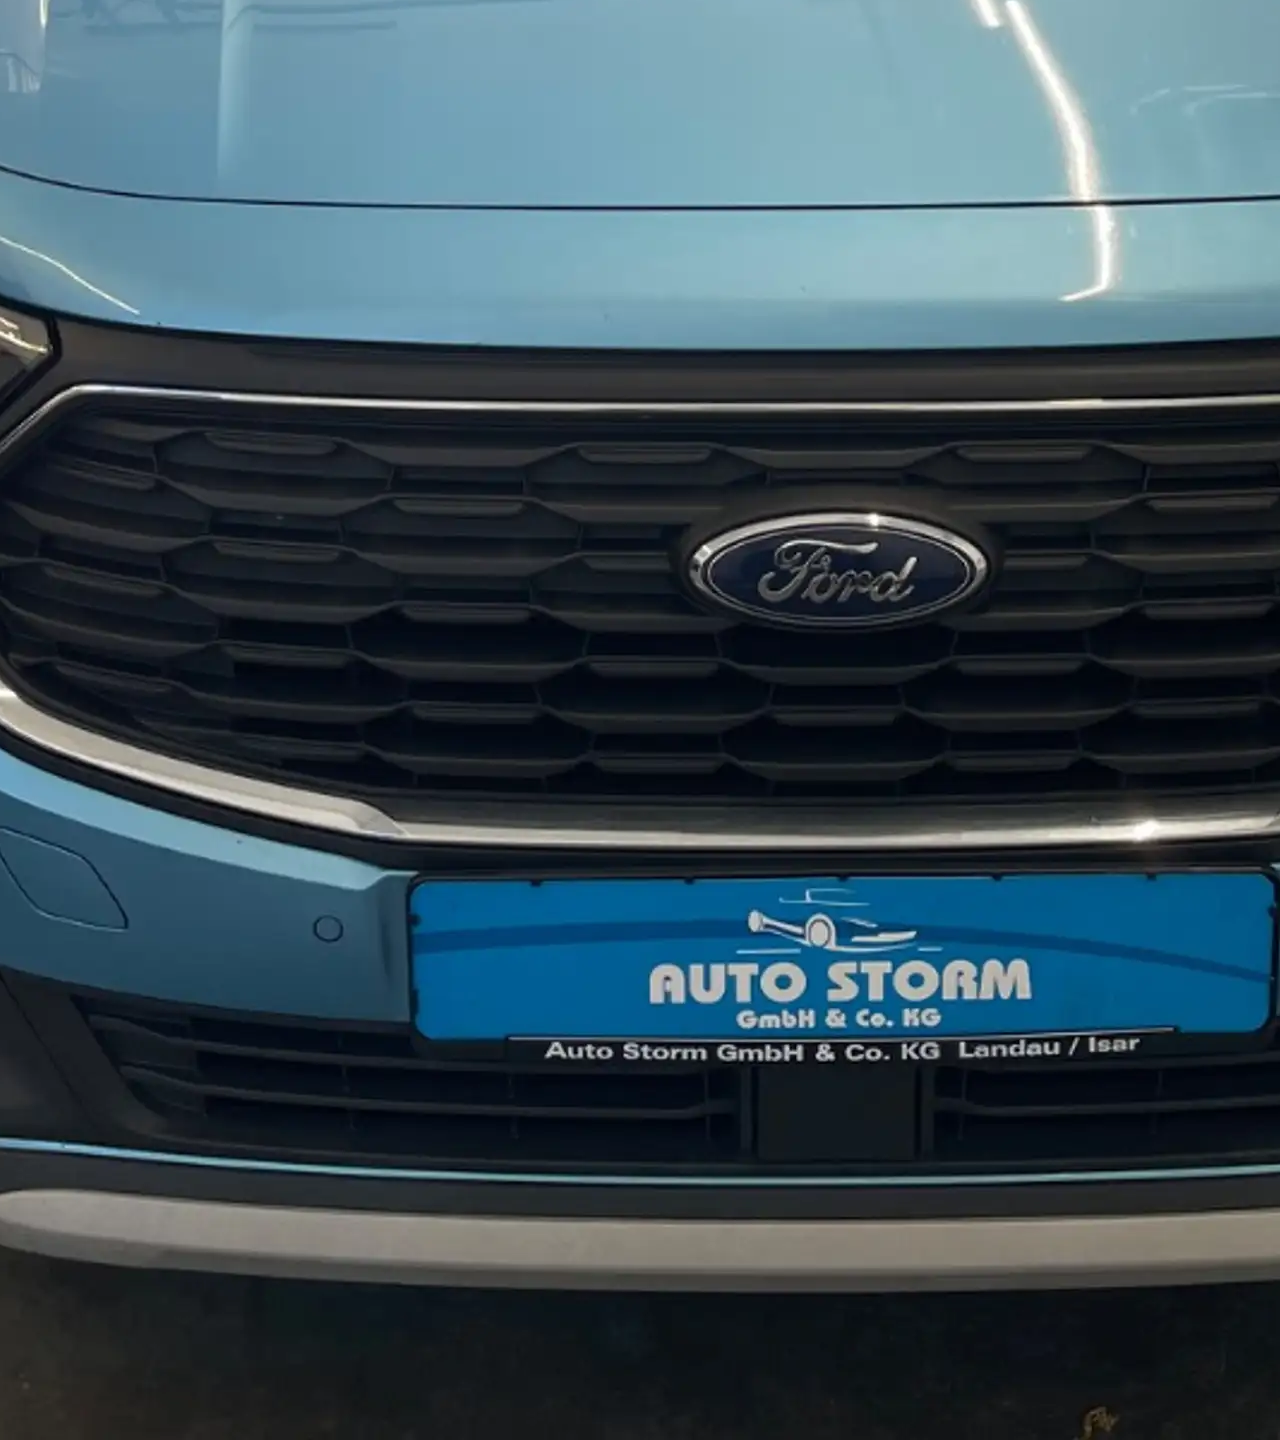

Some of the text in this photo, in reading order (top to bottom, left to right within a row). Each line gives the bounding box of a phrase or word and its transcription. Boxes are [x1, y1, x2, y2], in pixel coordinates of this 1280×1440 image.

[757, 538, 918, 604] Ford
[649, 958, 1032, 1004] AUTO STORM
[736, 1007, 942, 1029] GmbH & Co. KG
[544, 1035, 1141, 1062] Auto Storm GmbH & Co. KG Landau / Isar
